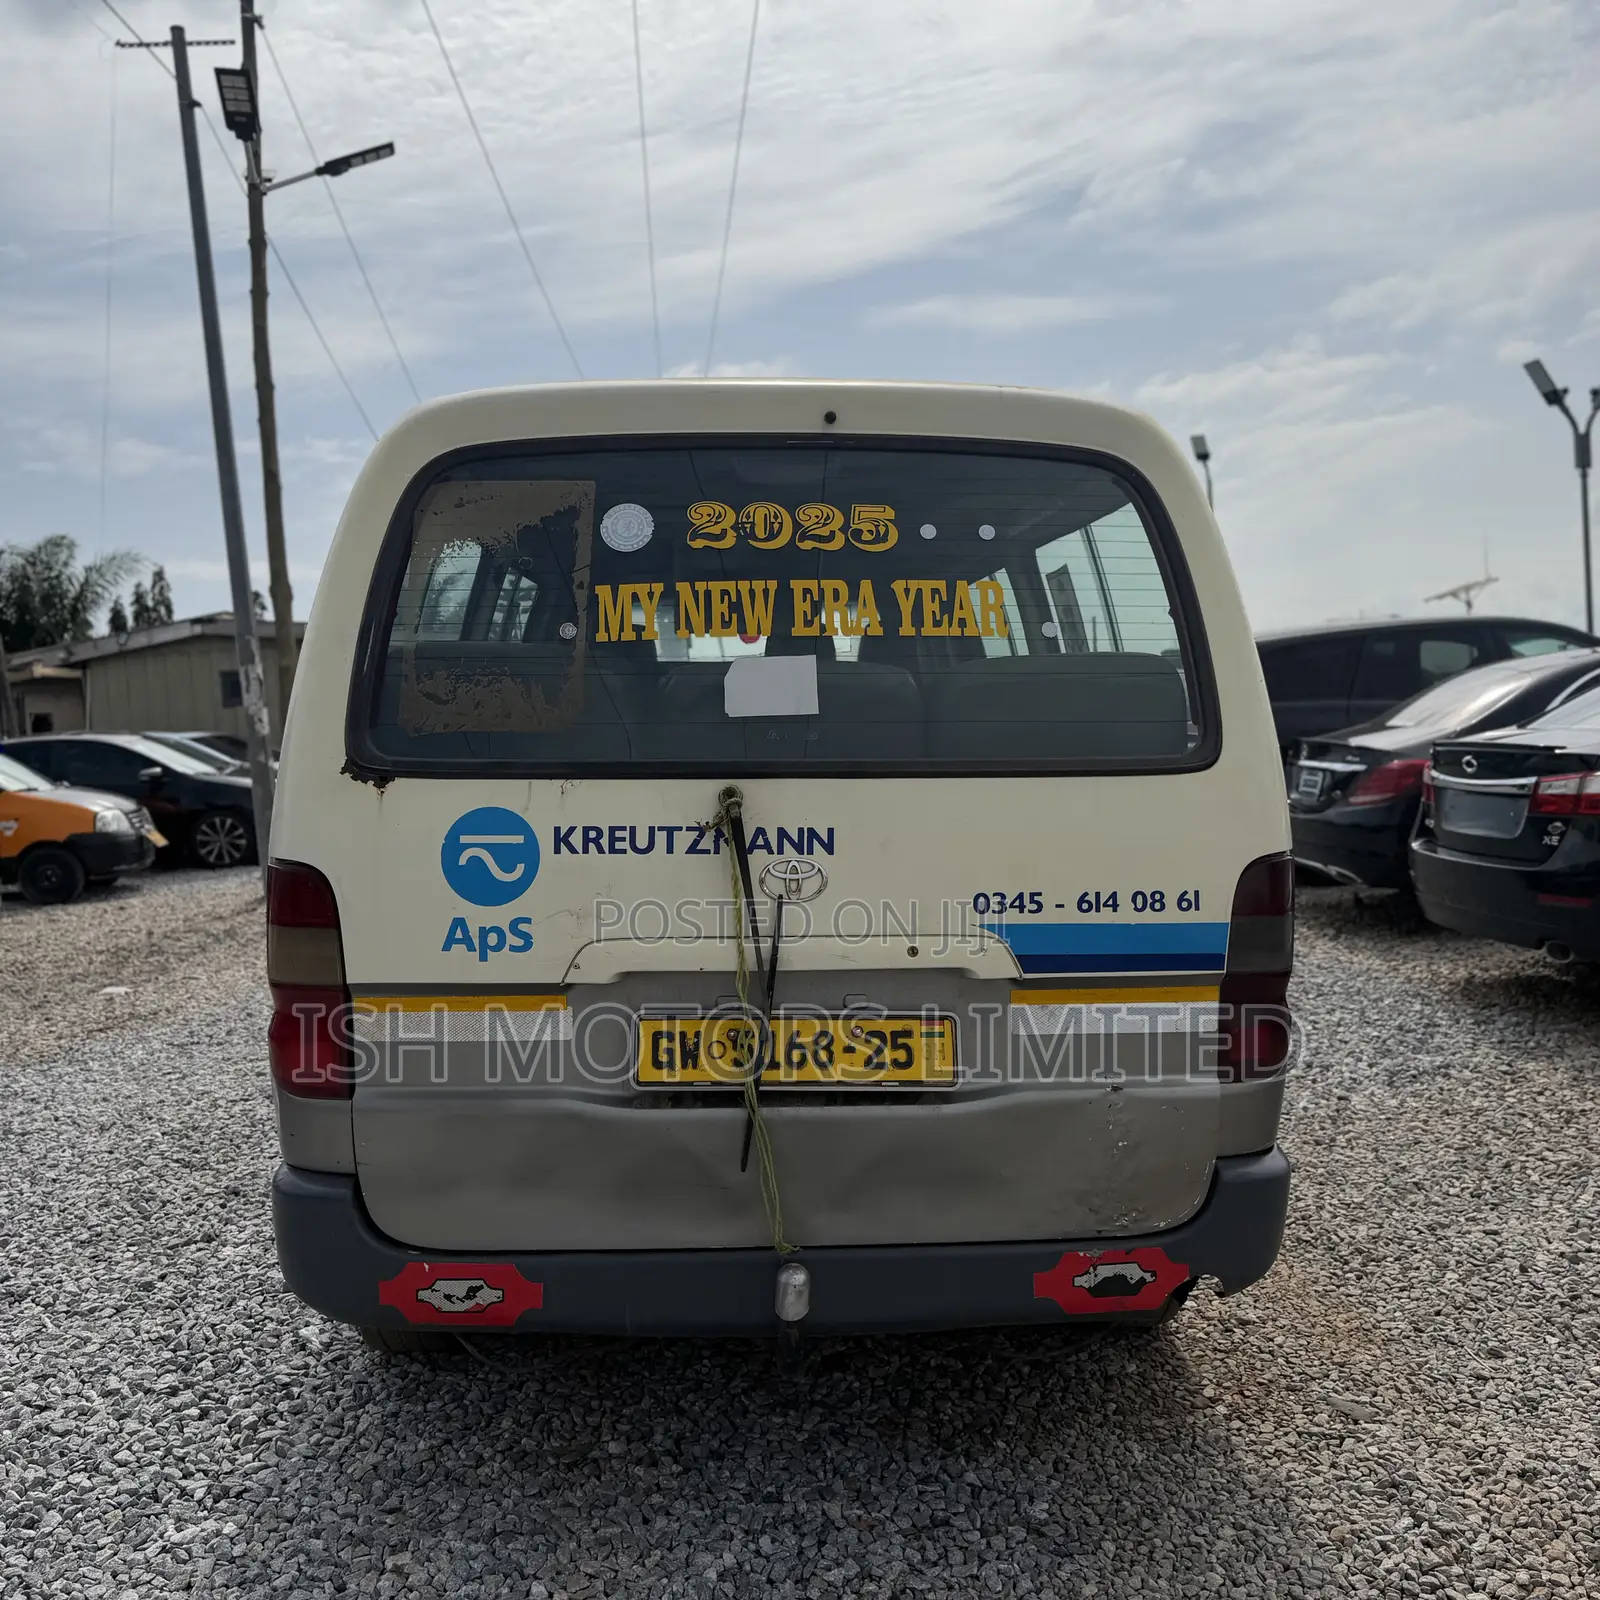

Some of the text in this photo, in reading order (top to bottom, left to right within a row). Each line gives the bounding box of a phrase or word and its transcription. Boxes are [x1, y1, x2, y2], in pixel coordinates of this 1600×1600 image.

[686, 501, 899, 553] 2025
[594, 578, 1010, 643] MY NEW ERA YEAR
[972, 891, 1044, 915] 0345
[1076, 890, 1119, 913] 614
[1131, 890, 1166, 913] 08
[1177, 889, 1200, 912] 61
[441, 916, 534, 963] ApS
[652, 1030, 702, 1070] GW
